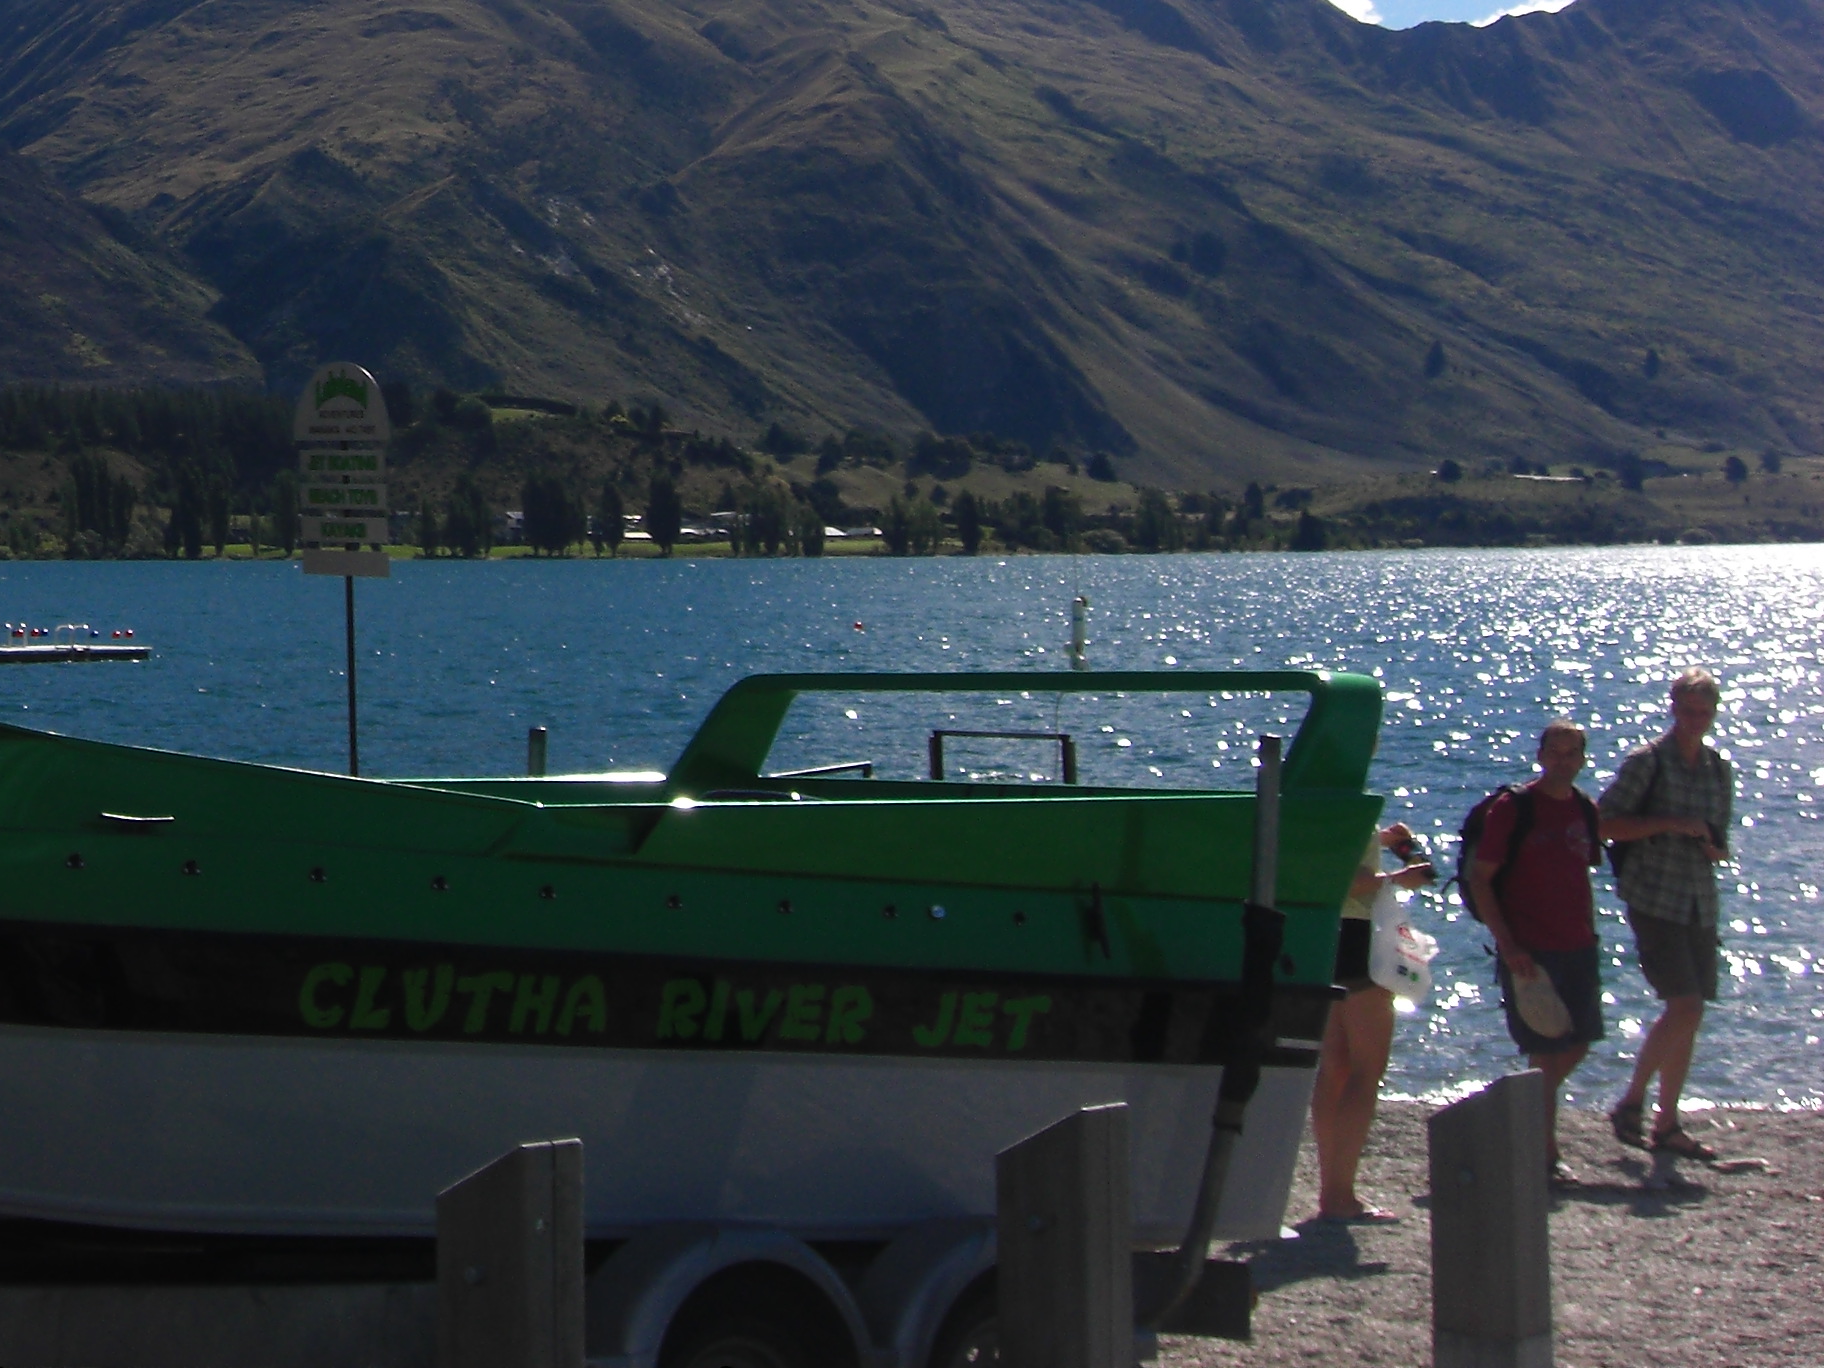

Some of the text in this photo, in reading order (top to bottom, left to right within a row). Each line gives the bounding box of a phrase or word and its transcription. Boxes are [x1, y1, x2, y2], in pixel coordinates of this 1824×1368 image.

[298, 962, 1052, 1052] CLUTHA RIVER JET
